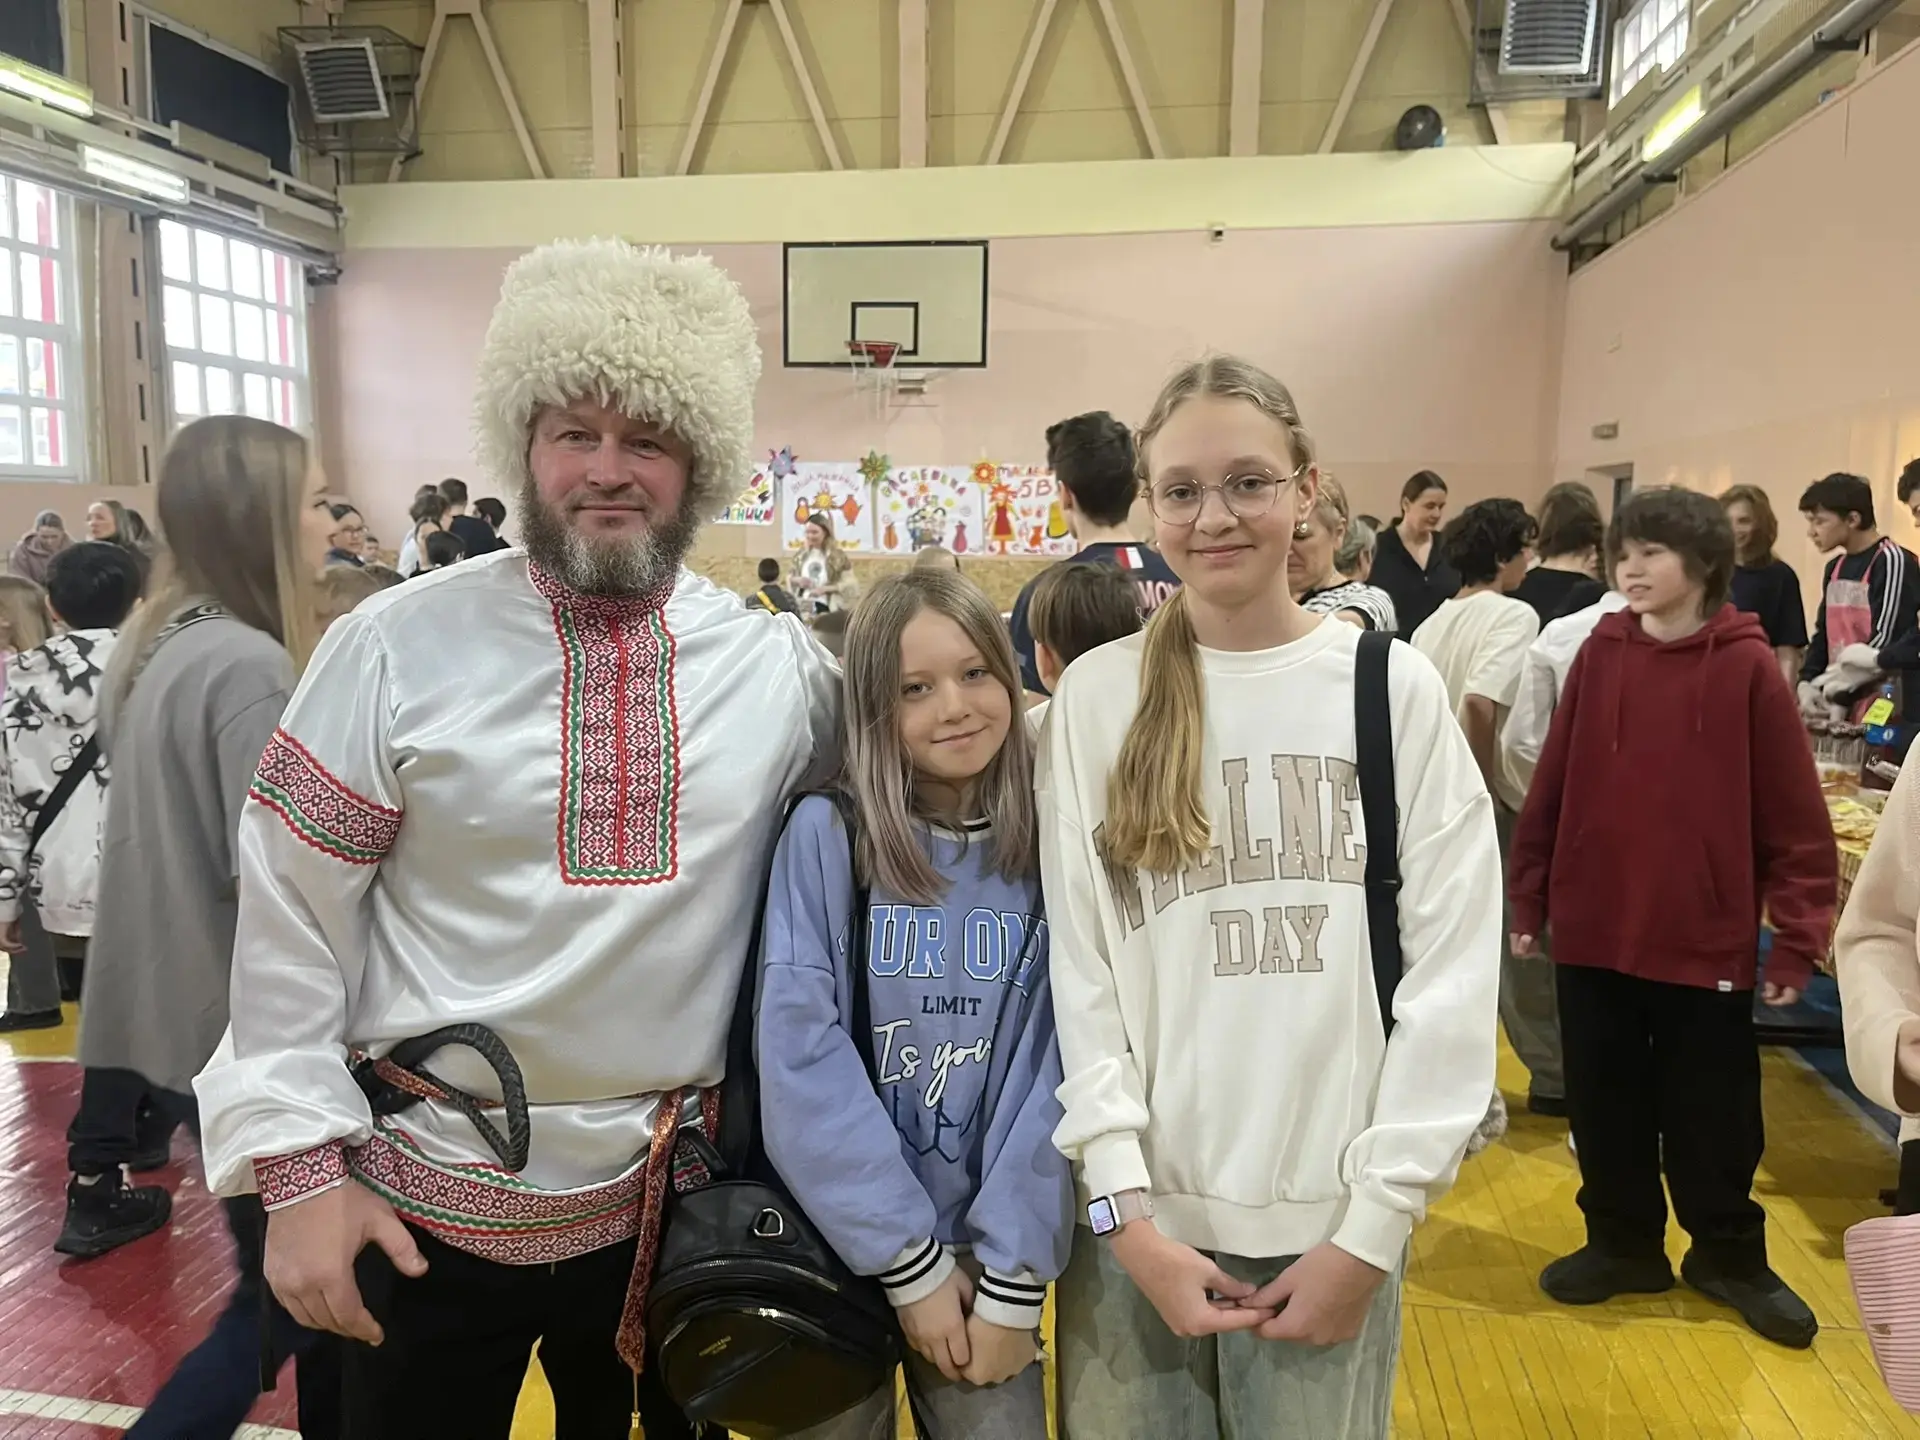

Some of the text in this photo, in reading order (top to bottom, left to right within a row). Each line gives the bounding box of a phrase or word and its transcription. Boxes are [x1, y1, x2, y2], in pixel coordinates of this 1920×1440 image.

[1091, 753, 1367, 943] WLNE
[838, 903, 947, 979] UR
[1210, 904, 1329, 977] DAY
[921, 995, 982, 1016] LIMIT
[873, 1018, 922, 1085] Is
